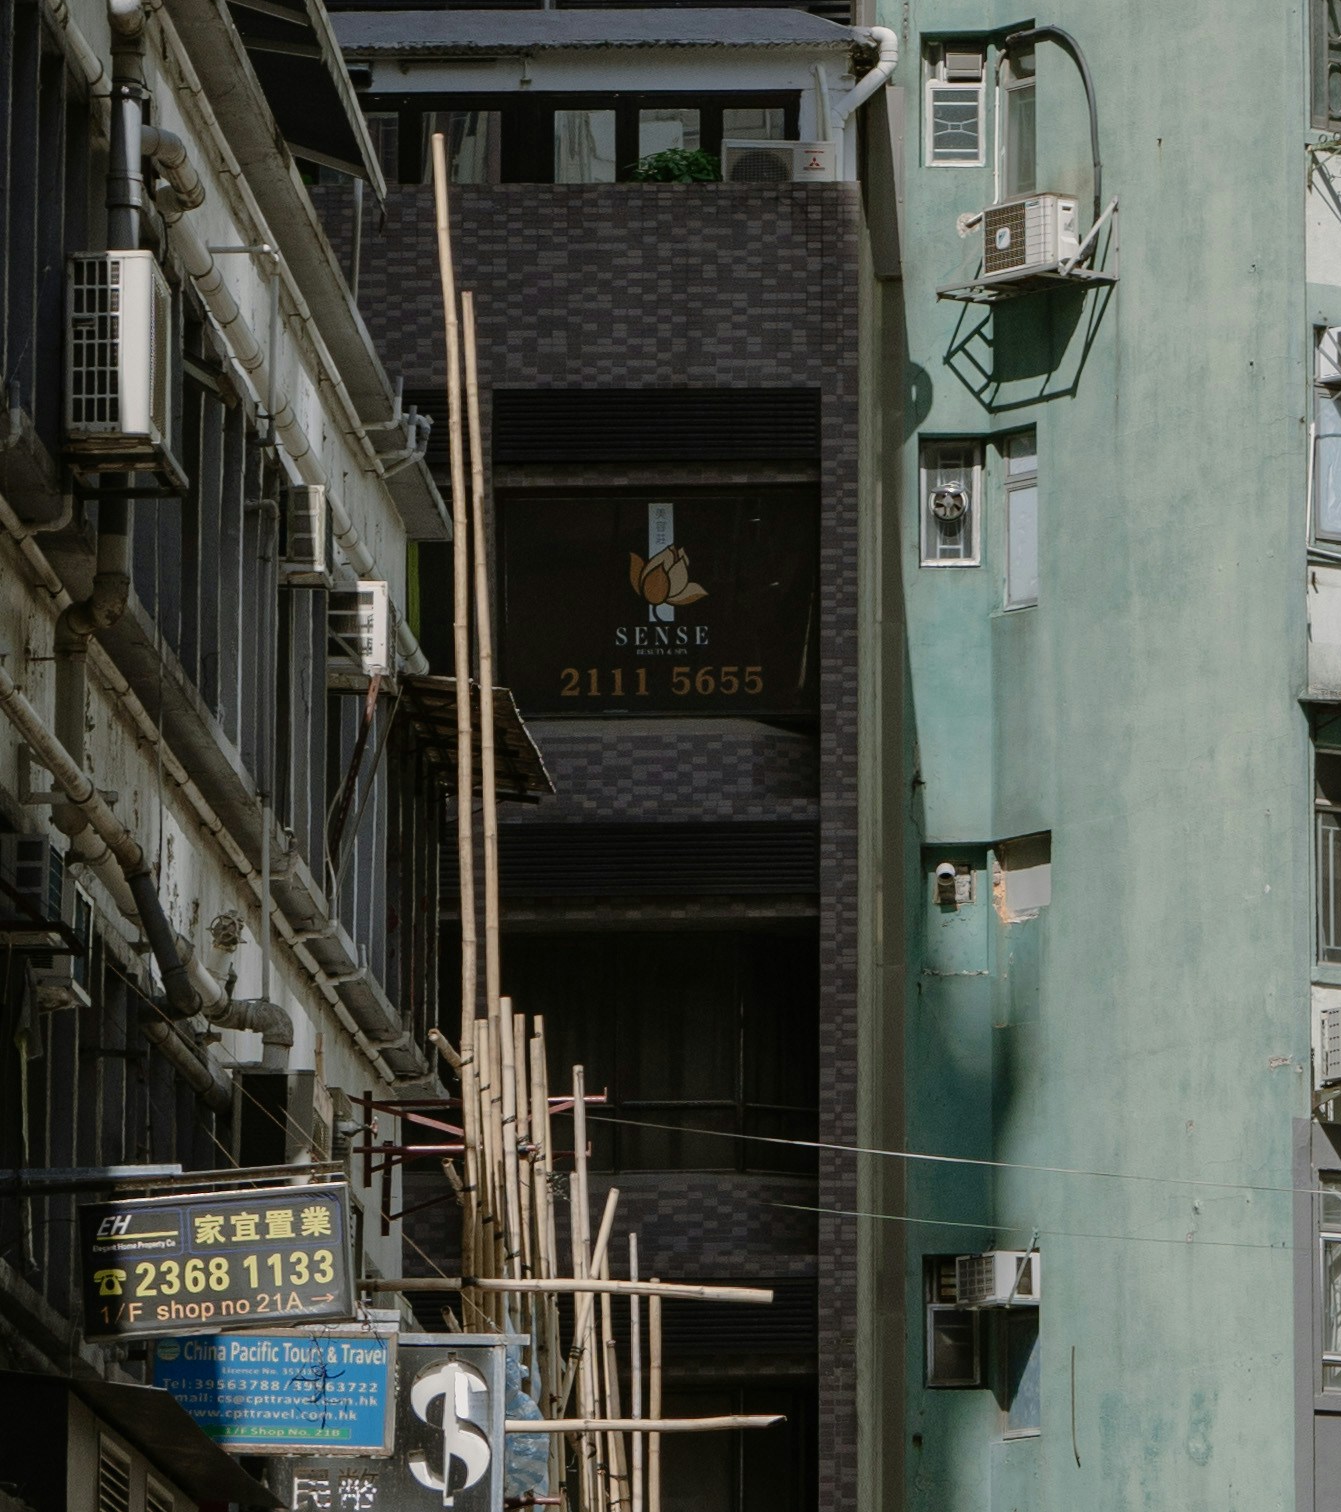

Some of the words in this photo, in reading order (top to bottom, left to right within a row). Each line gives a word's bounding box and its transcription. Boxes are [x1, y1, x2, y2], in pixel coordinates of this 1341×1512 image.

[615, 626, 709, 646] SENSE
[560, 667, 649, 696] 2111
[671, 666, 764, 695] 5655
[97, 1214, 132, 1236] EH
[194, 1206, 331, 1245] 家宜置業
[118, 1241, 136, 1251] Home
[138, 1240, 166, 1251] Property
[135, 1257, 230, 1298] 2368
[243, 1249, 335, 1288] 1133
[100, 1302, 143, 1324] 1/F
[156, 1300, 215, 1321] shop
[221, 1300, 250, 1316] no
[256, 1291, 303, 1313] 21A
[183, 1341, 226, 1361] China
[230, 1342, 279, 1363] Pacific
[282, 1342, 324, 1363] Tours
[327, 1346, 338, 1363] &
[341, 1343, 387, 1365] Travel
[250, 1427, 285, 1438] Shop
